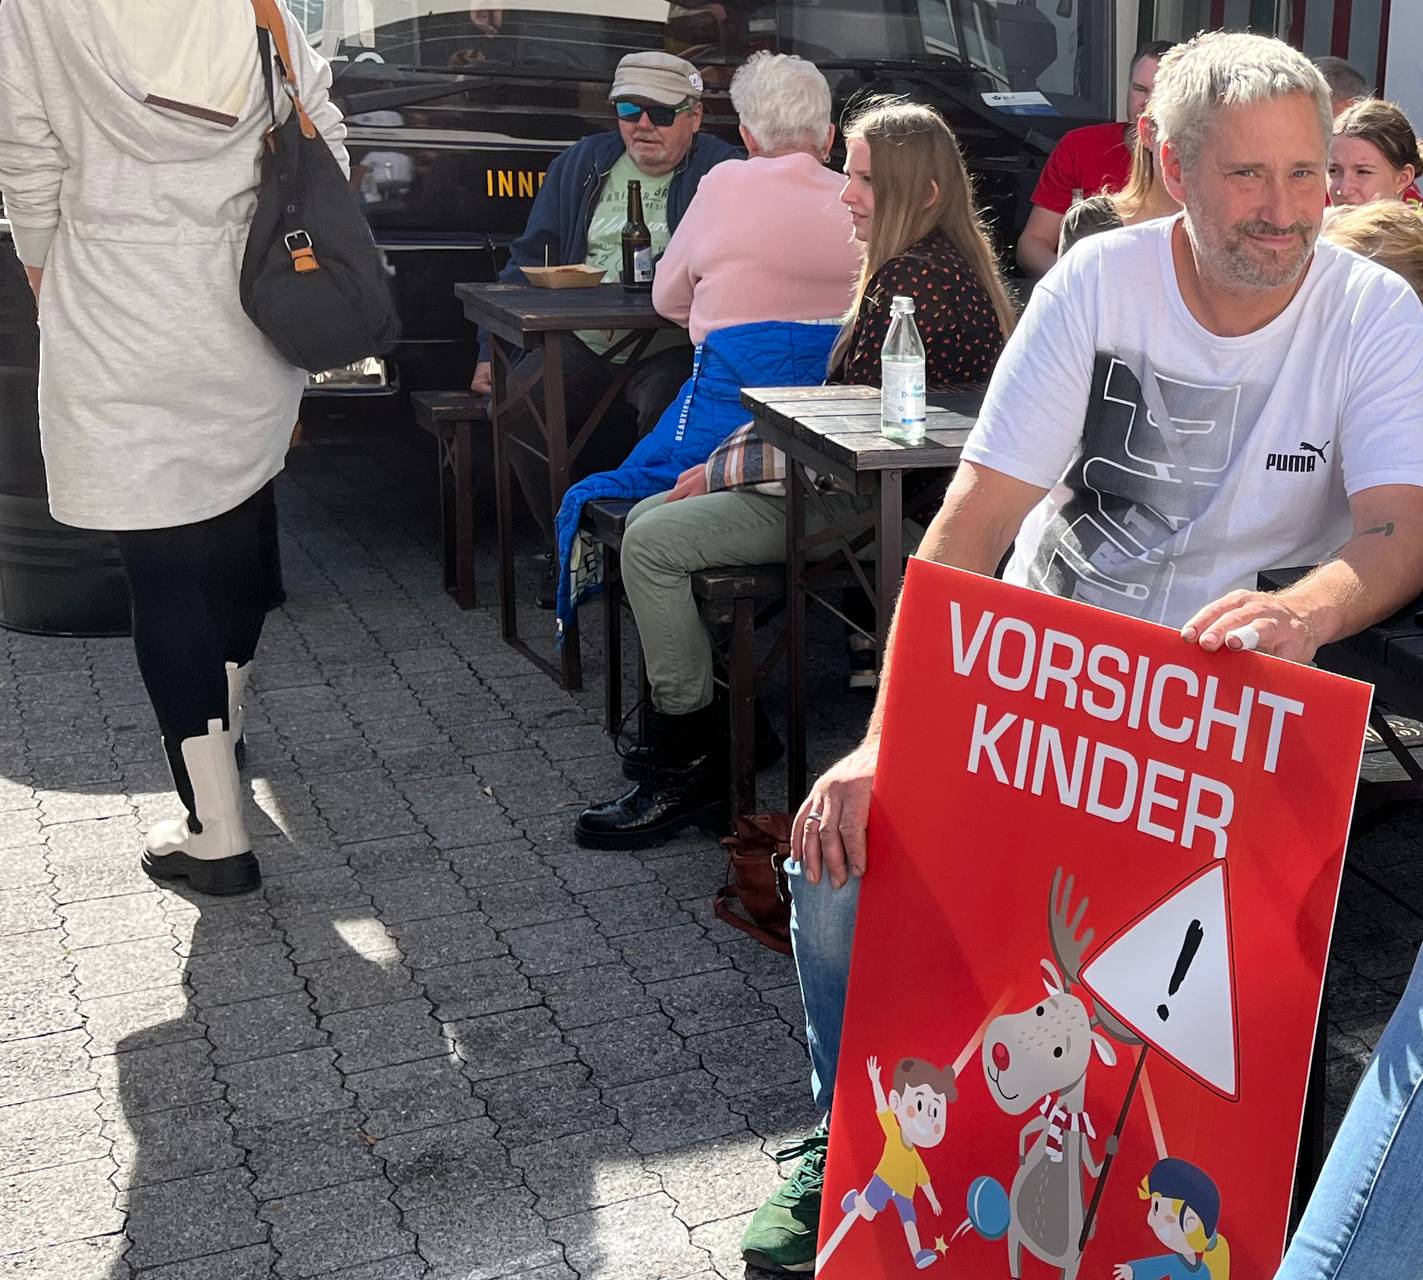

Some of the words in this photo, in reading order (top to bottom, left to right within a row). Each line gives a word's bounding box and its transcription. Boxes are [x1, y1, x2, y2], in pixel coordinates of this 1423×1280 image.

[1266, 453, 1317, 473] PUMA
[949, 600, 1305, 774] VORSICHT
[966, 702, 1235, 859] KINDER
